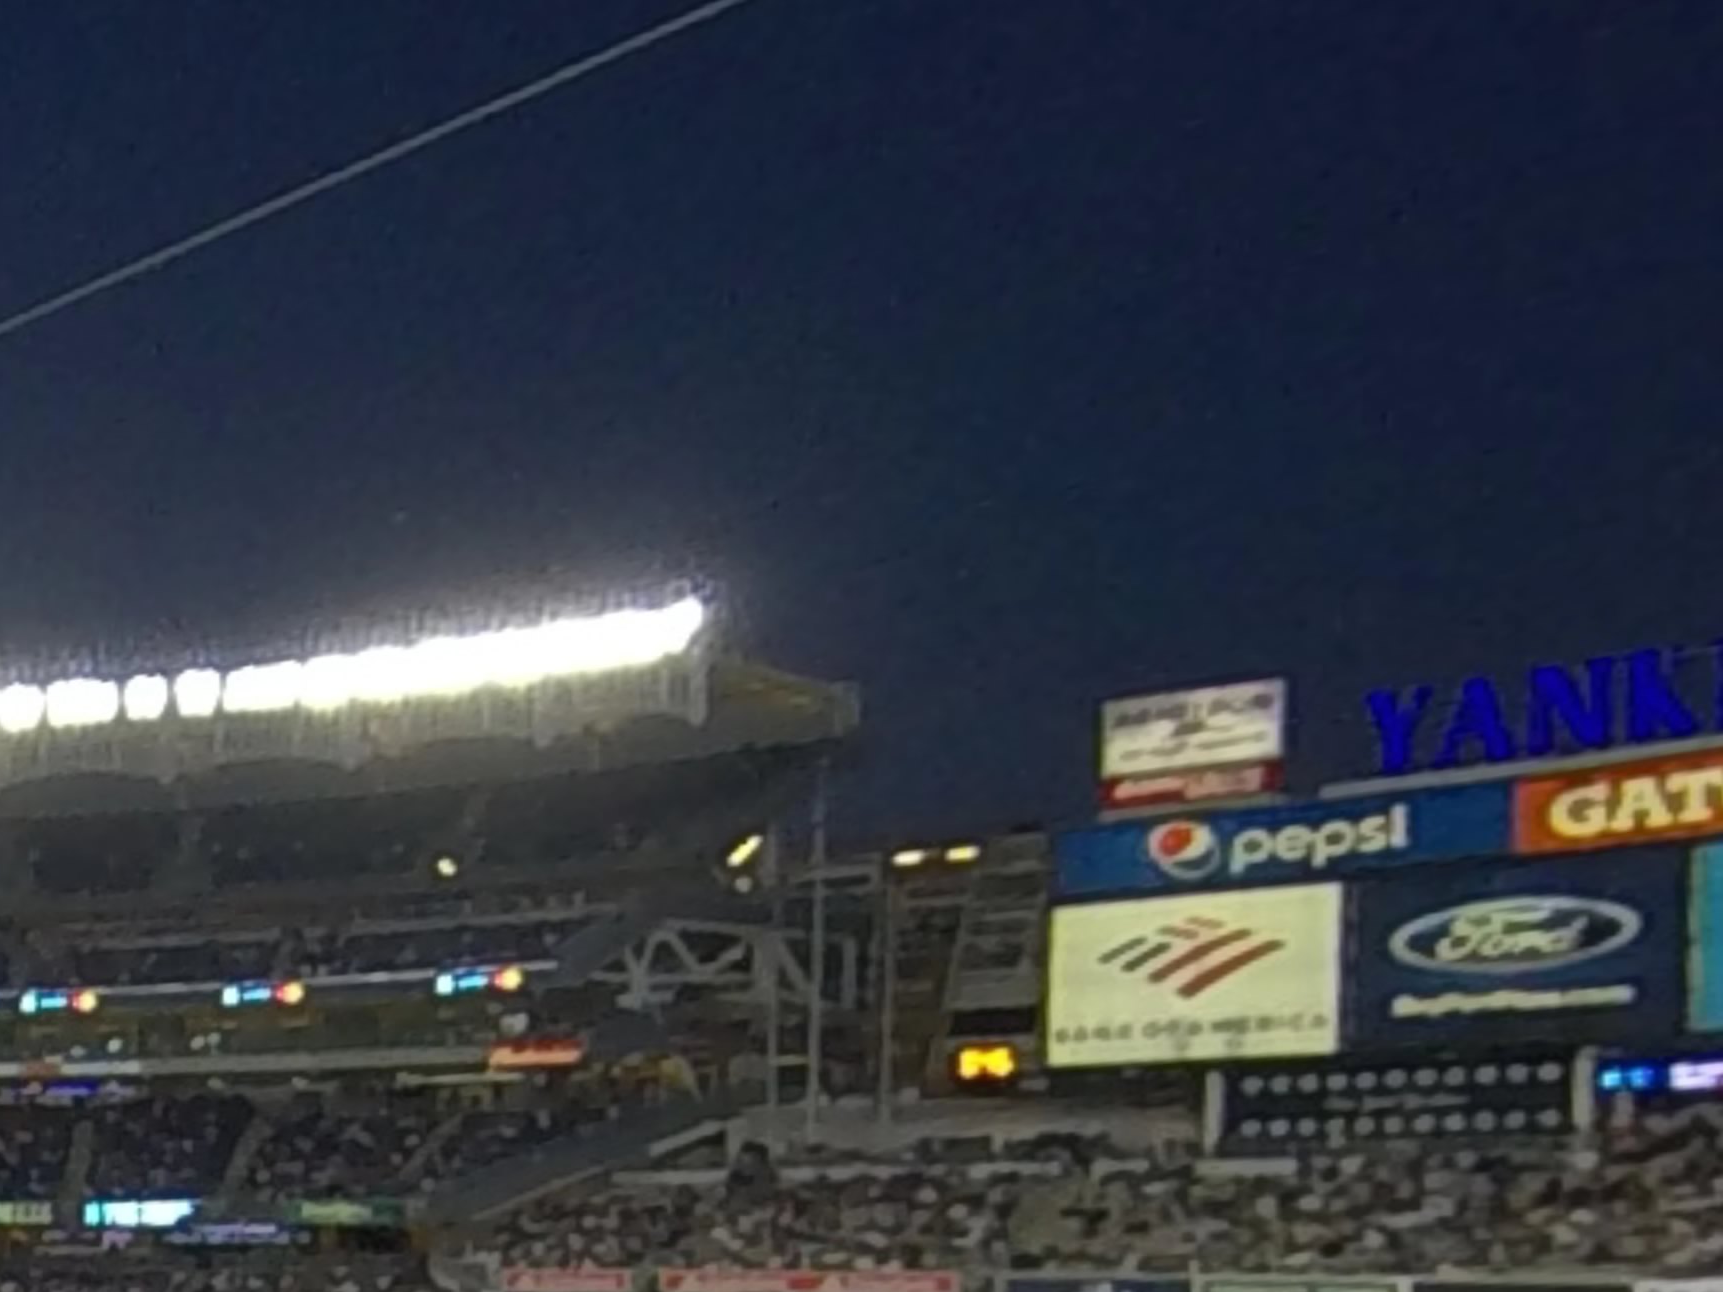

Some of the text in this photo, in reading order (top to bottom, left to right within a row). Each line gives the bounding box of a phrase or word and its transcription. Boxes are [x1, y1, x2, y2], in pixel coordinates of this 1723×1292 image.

[1367, 642, 1723, 776] YANK
[1229, 803, 1409, 873] pepsi
[1435, 908, 1591, 960] Ford
